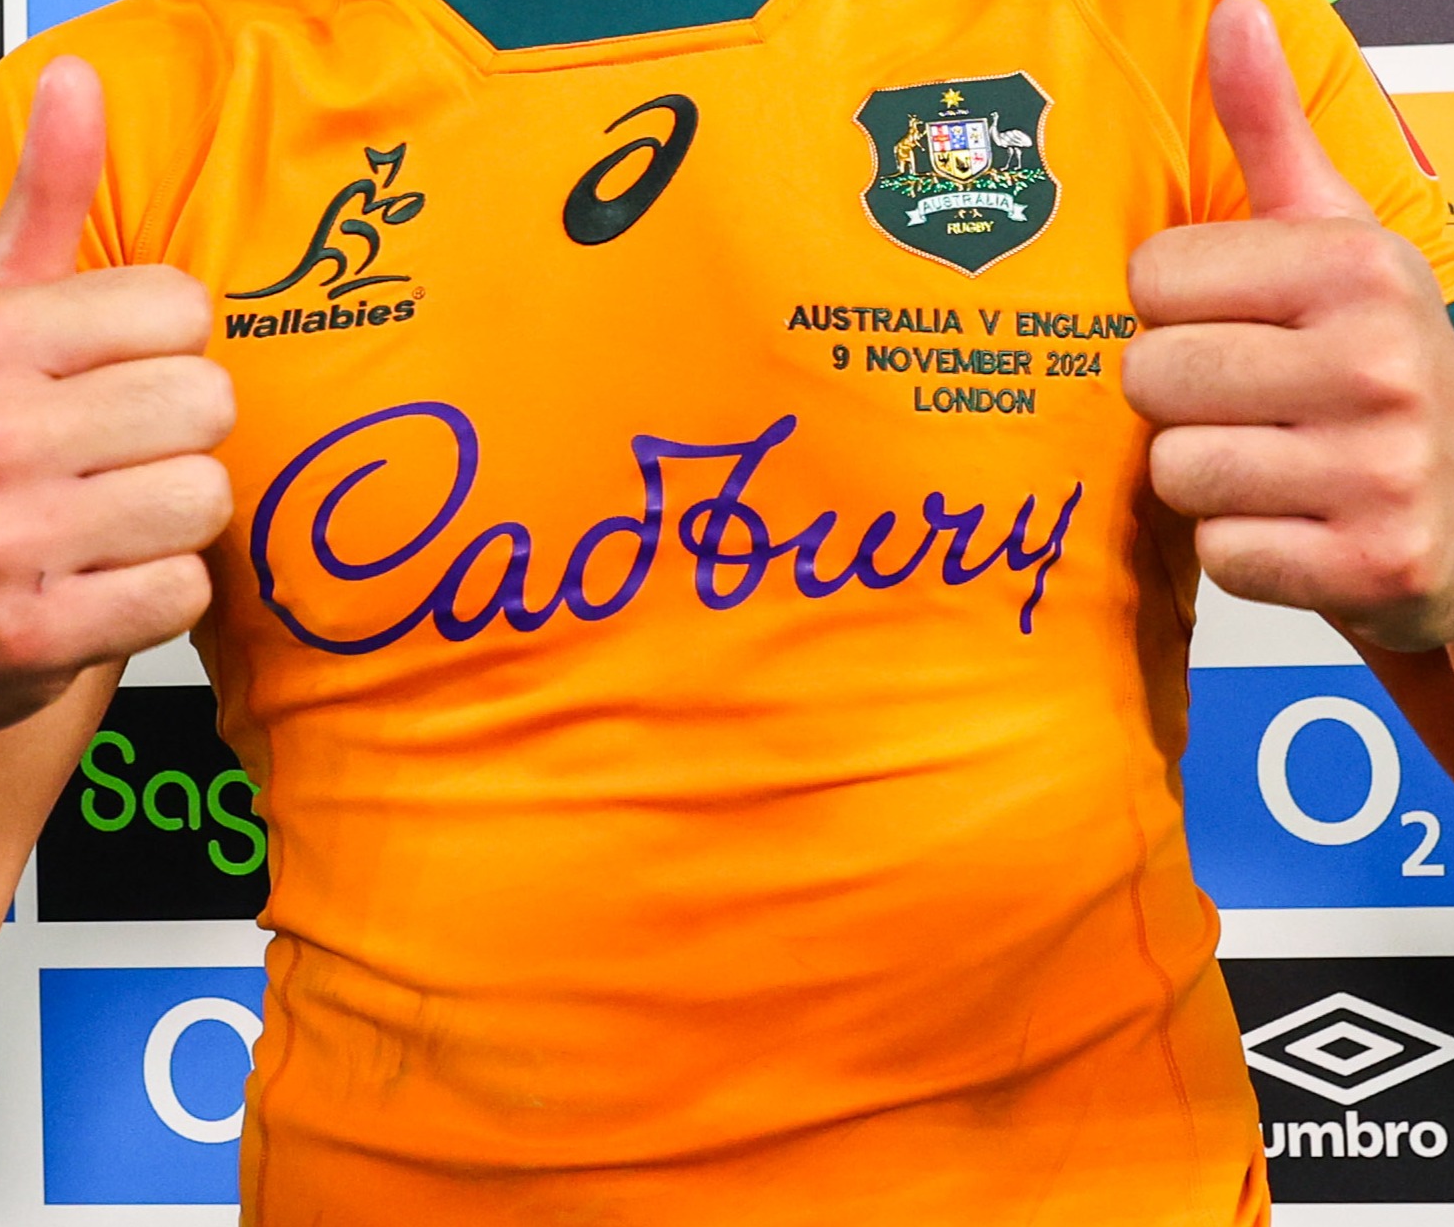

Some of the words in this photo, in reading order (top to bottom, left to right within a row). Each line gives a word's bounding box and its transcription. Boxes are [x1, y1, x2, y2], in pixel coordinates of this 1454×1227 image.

[922, 193, 1010, 212] AUSTRALIA
[946, 220, 995, 235] RUGBY
[225, 299, 416, 340] Wallabies
[787, 304, 964, 335] AUSTRALIA
[977, 308, 1001, 336] V
[1015, 310, 1139, 341] ENGLAND
[831, 343, 852, 371] 9
[865, 345, 1034, 376] NOVEMBER
[1045, 350, 1102, 378] 2024
[913, 384, 1036, 415] LONDON
[253, 402, 1082, 653] Cadbury
[81, 731, 266, 875] Sag
